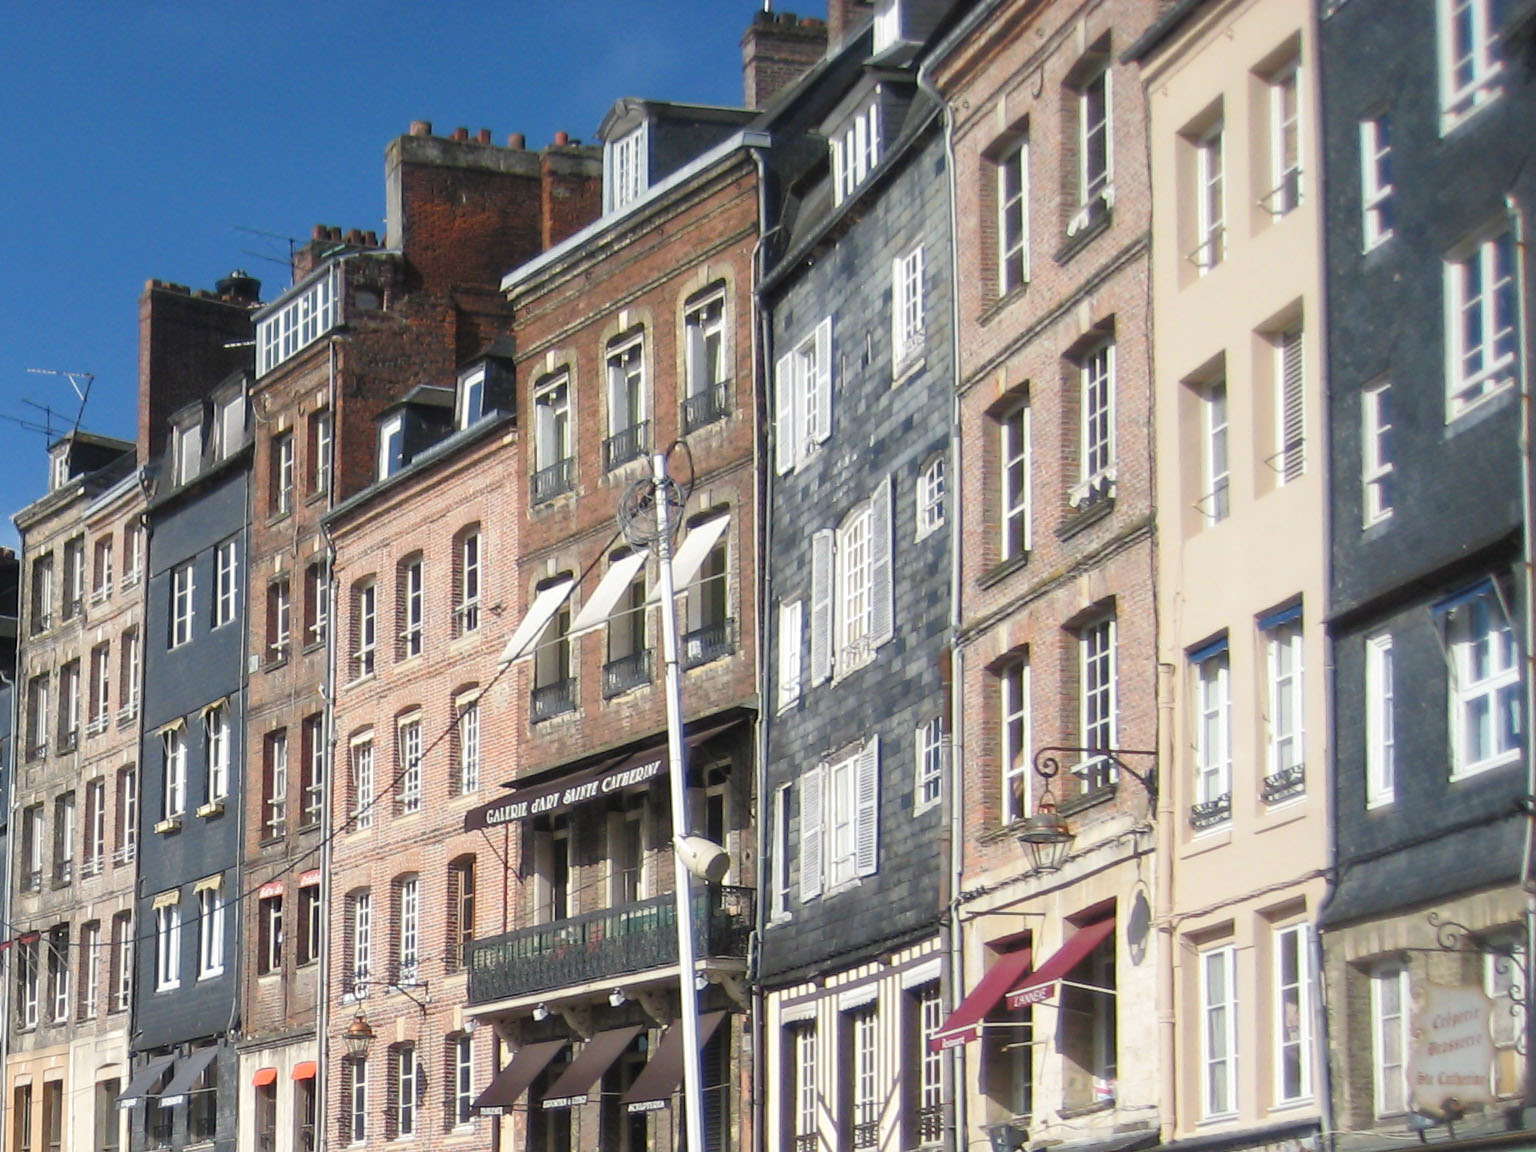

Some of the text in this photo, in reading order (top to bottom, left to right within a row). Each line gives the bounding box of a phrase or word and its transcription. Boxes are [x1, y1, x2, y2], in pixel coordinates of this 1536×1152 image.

[486, 801, 527, 825] GALERIE
[563, 780, 600, 804] SAINTE
[601, 759, 663, 793] CATHERINE
